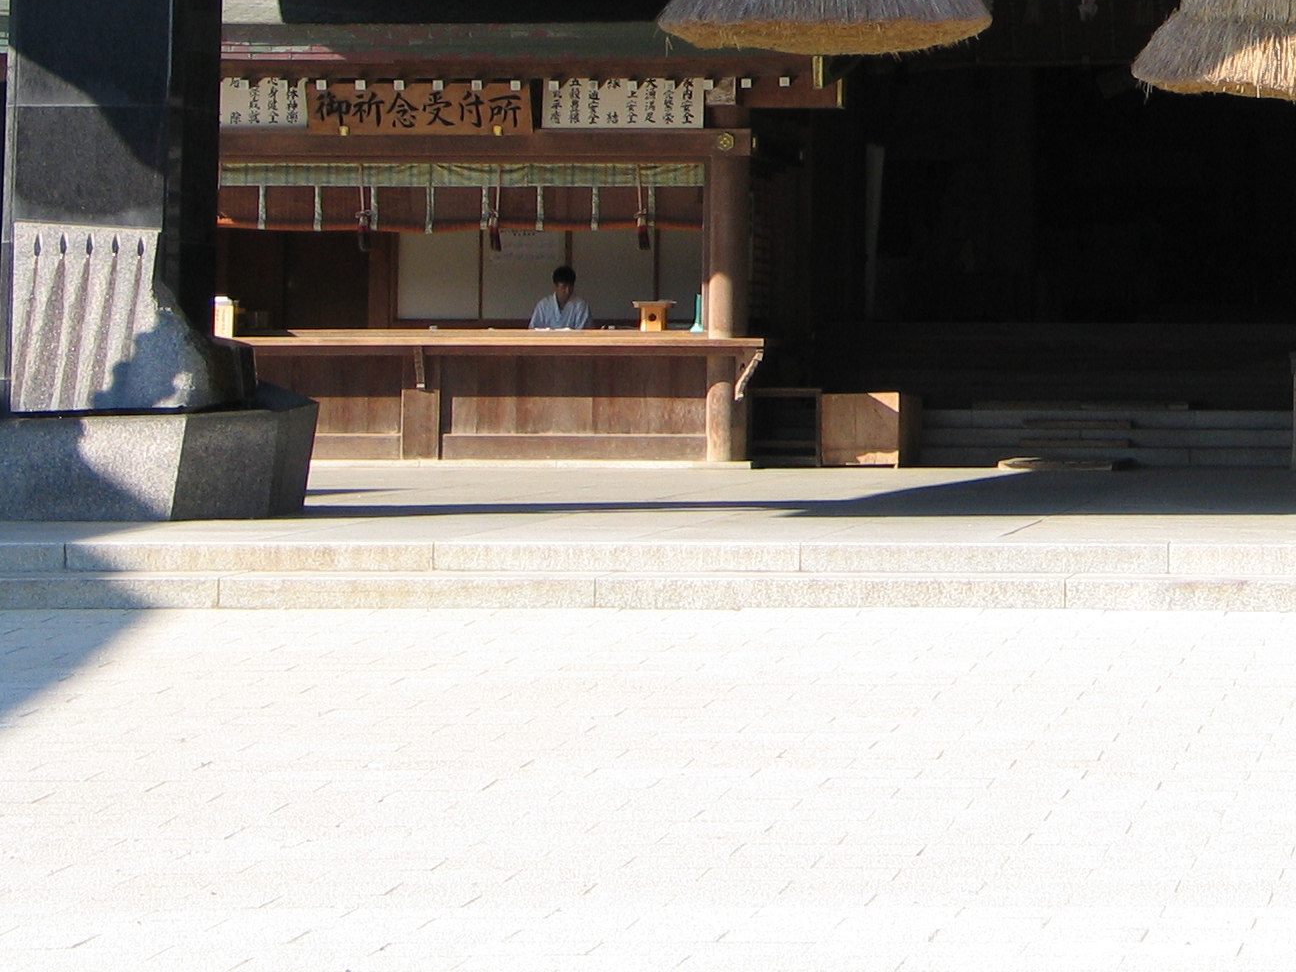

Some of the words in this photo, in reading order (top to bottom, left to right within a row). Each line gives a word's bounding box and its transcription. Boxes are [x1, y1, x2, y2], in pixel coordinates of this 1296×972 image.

[315, 92, 523, 129] 御祈念受付所
